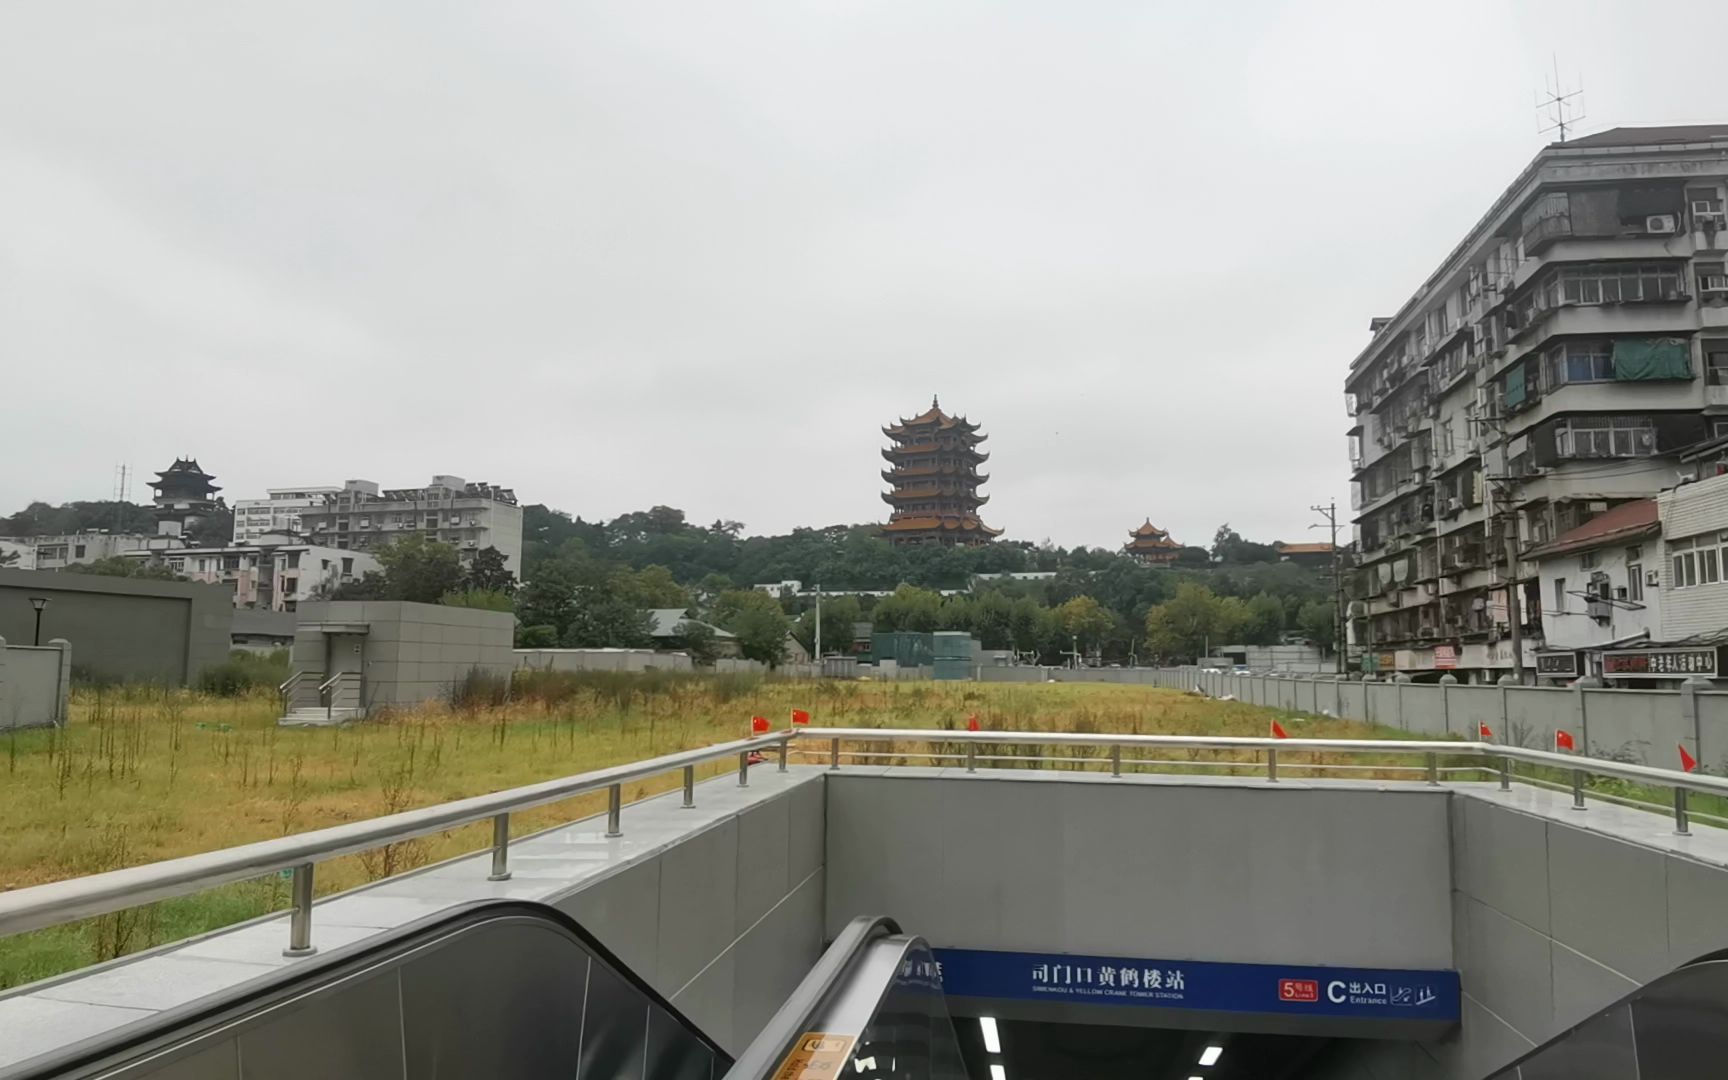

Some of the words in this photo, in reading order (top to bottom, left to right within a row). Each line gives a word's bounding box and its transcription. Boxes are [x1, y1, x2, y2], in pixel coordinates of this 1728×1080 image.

[1032, 964, 1185, 990] 司门口黄鹤楼站
[1104, 989, 1127, 997] CRANE
[1129, 990, 1153, 998] TOWER
[1155, 992, 1184, 1000] STATION
[1327, 980, 1346, 1003] C
[1350, 983, 1386, 995] 出入口
[1350, 995, 1387, 1005] Entrance
